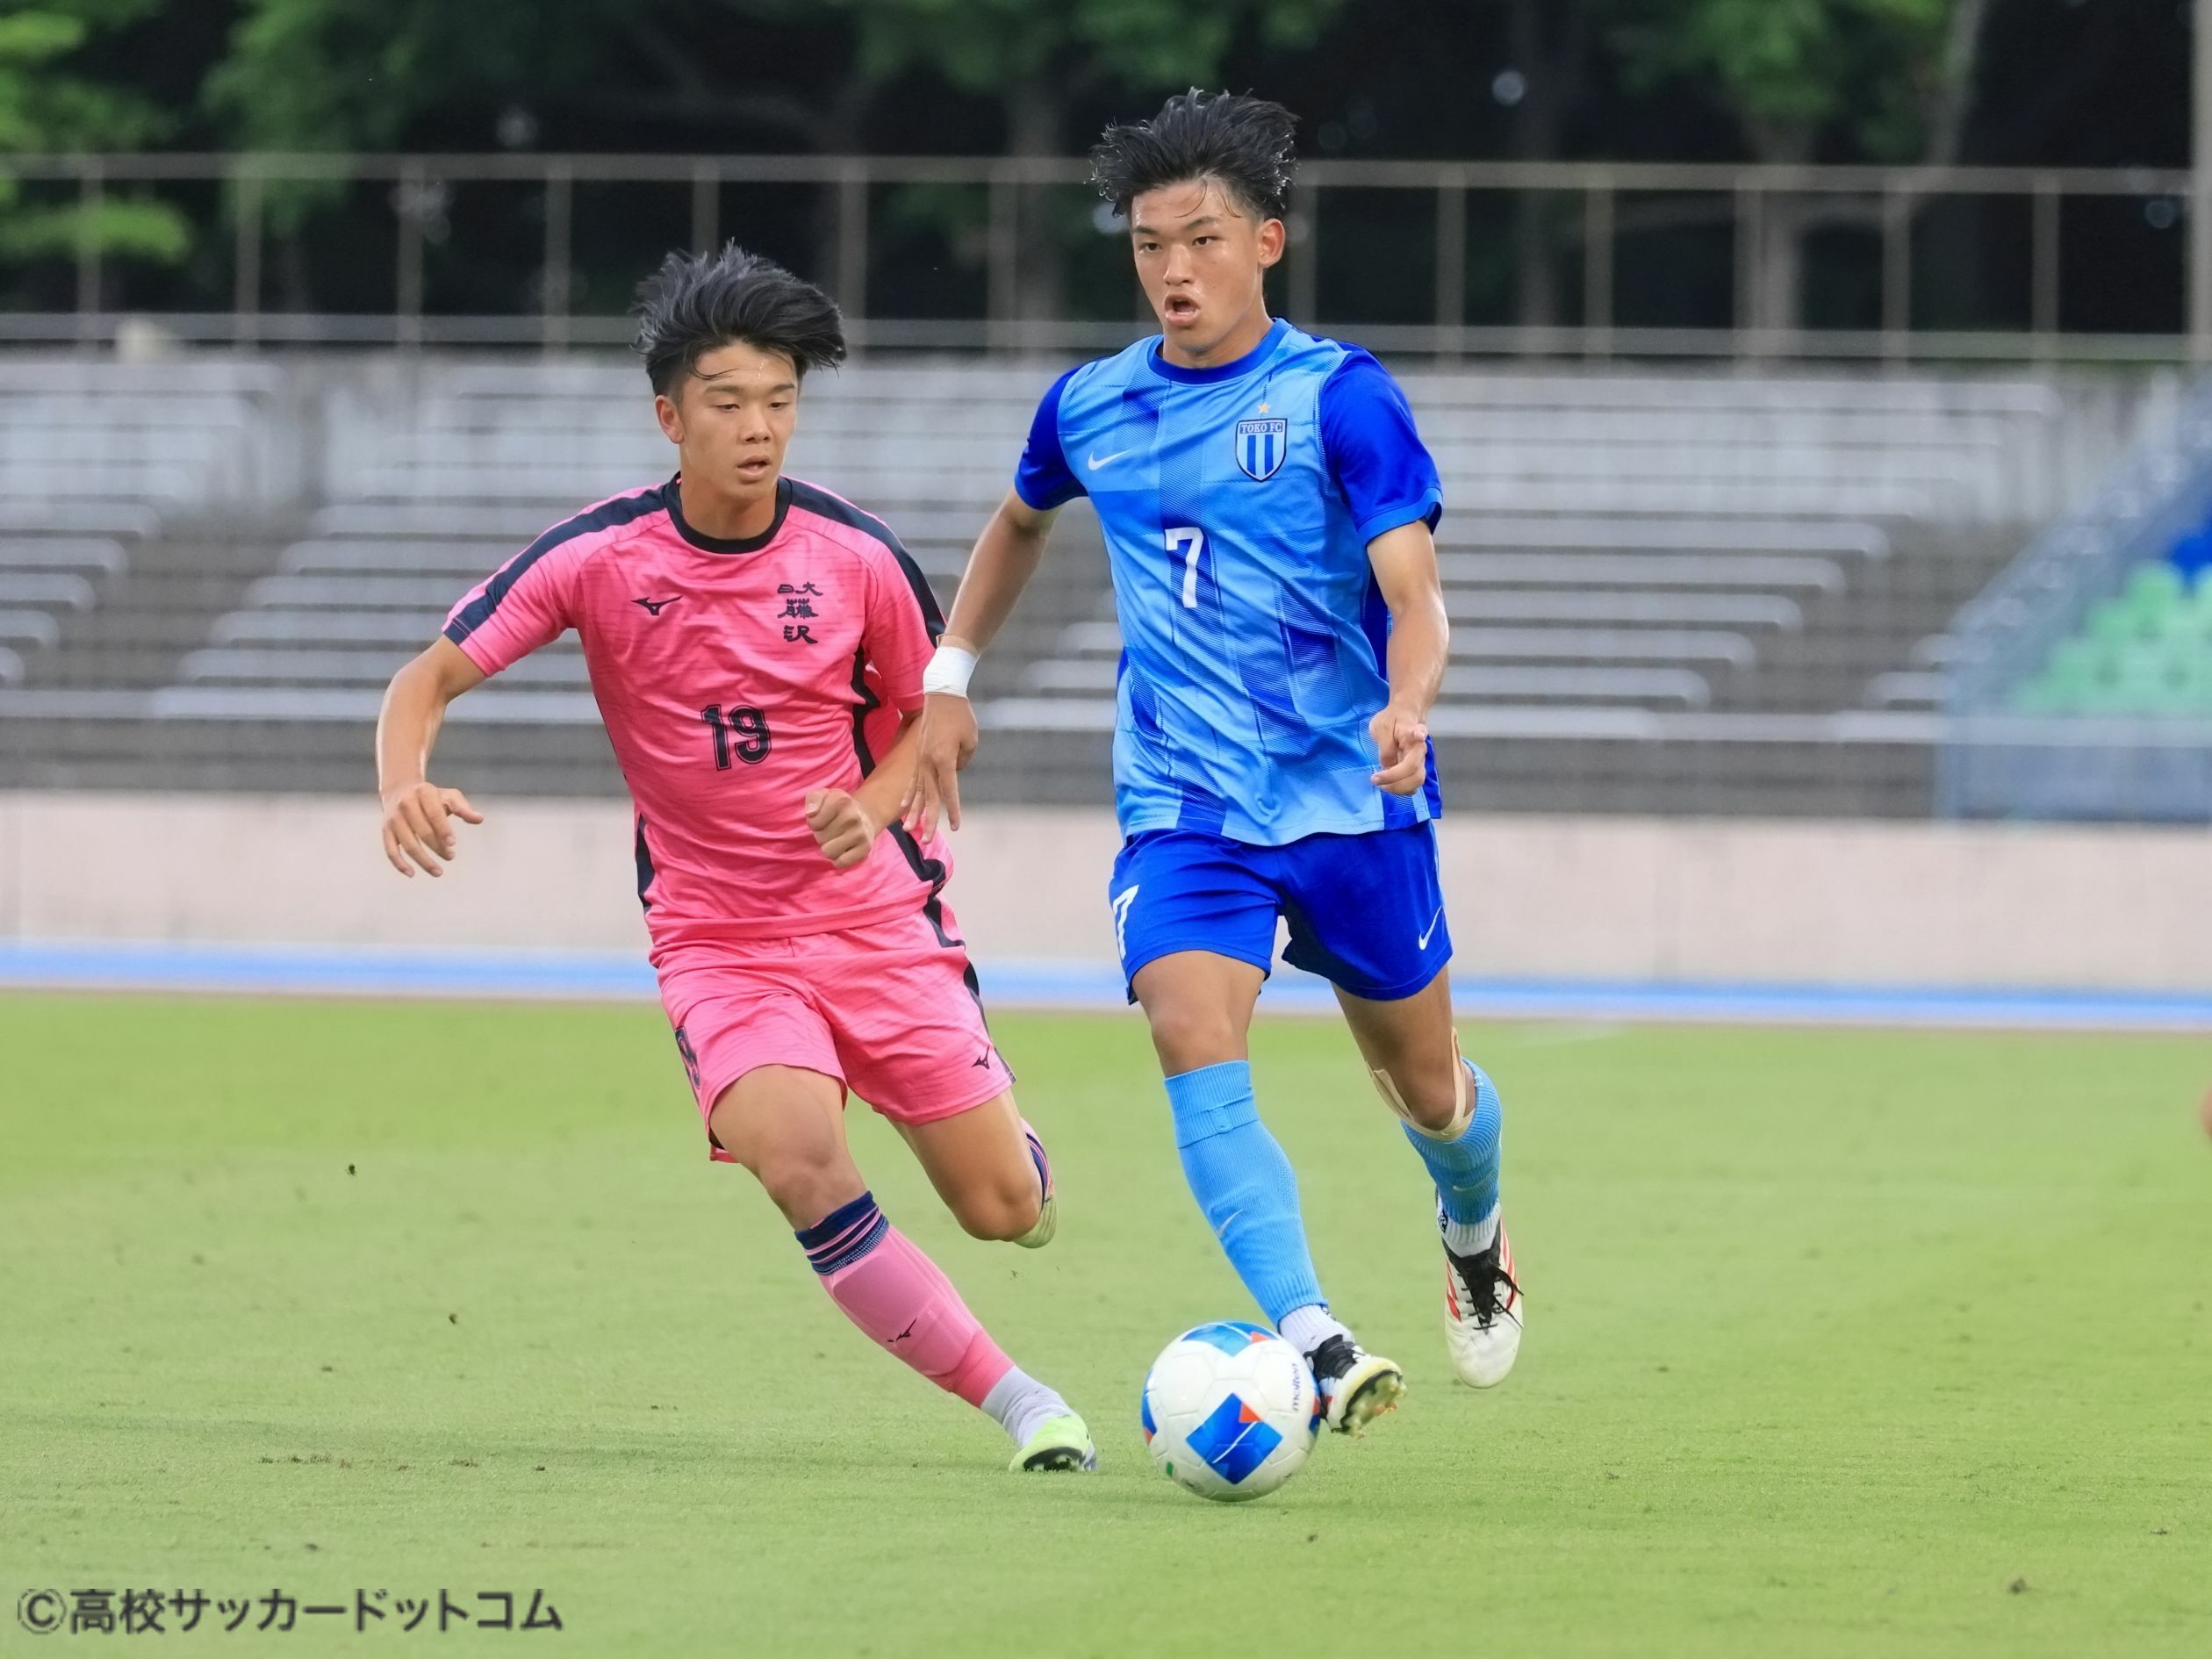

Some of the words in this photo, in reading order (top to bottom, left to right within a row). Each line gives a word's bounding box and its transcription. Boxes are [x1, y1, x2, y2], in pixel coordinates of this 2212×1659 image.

[1241, 423, 1267, 434] TOKO
[1269, 422, 1282, 433] FC
[1164, 527, 1204, 609] 7
[700, 703, 772, 772] 19
[1112, 884, 1140, 961] 7
